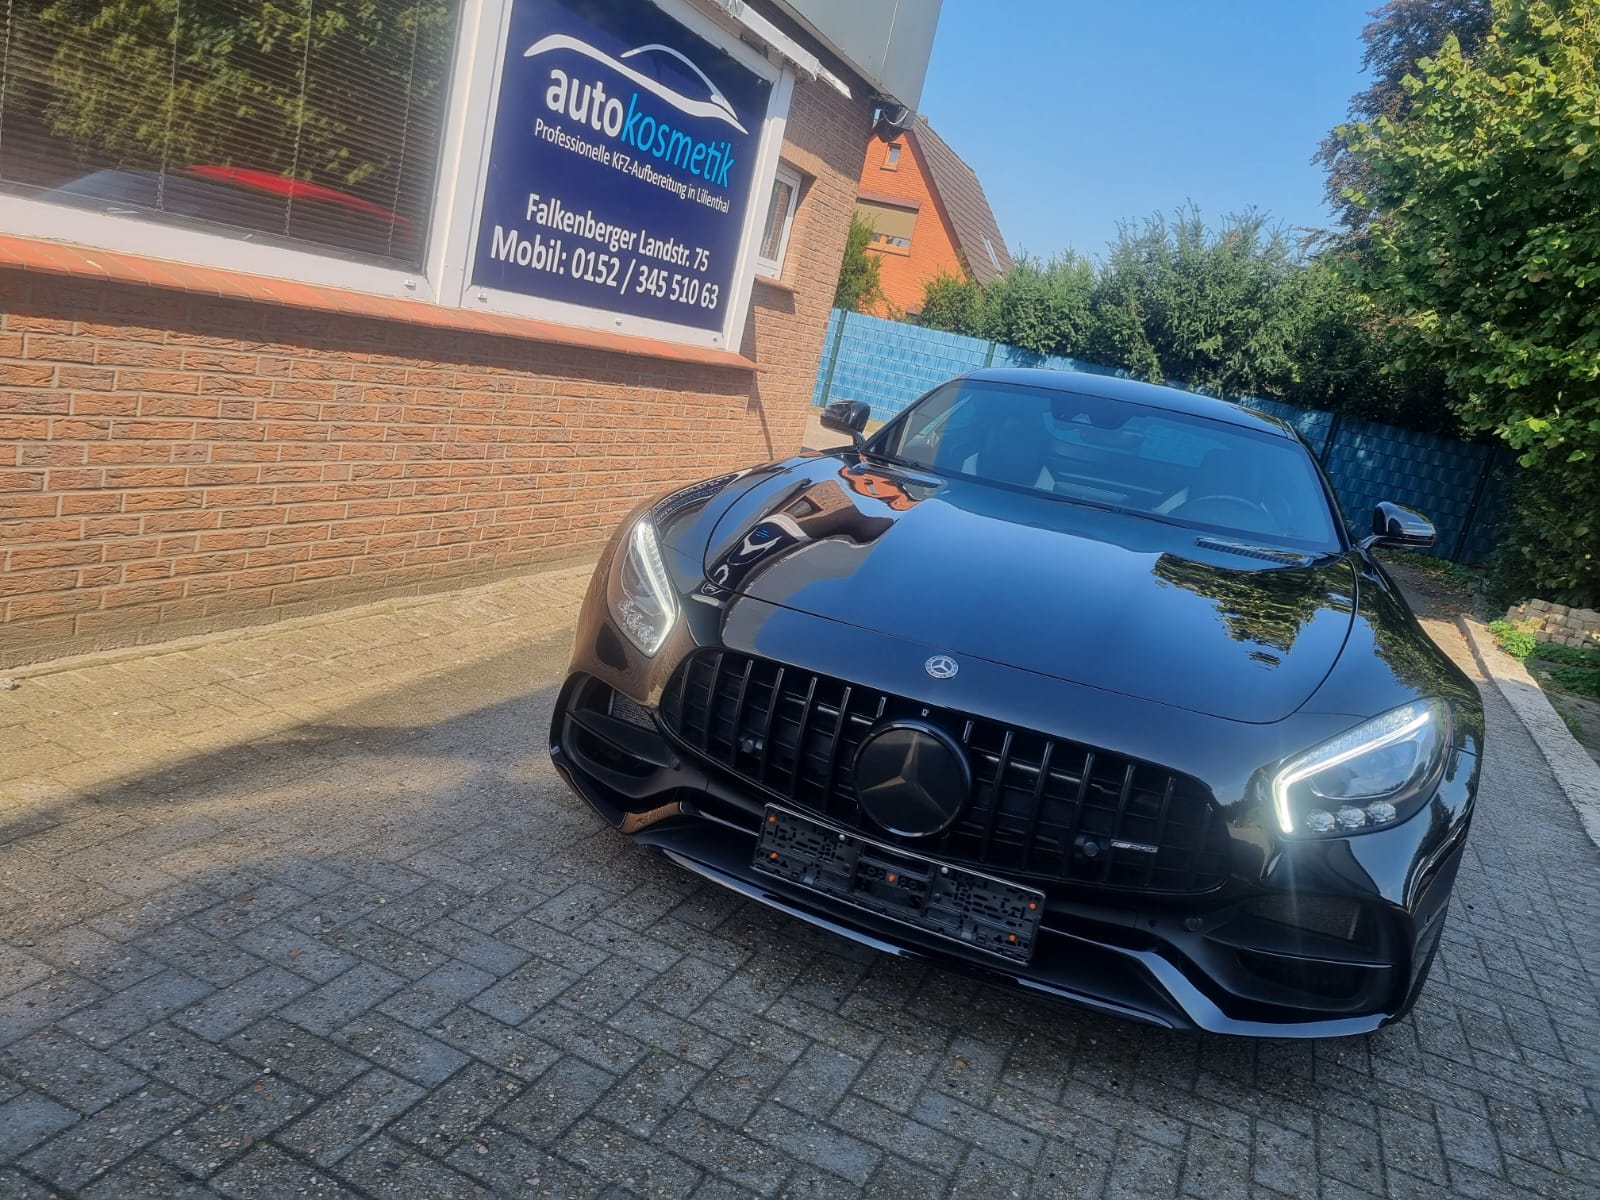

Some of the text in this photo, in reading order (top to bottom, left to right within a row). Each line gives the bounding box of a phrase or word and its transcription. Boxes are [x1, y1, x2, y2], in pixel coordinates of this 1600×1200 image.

[534, 118, 730, 214] Professionelle KFZ-Aufbereitung in Lilienthal
[546, 68, 735, 188] autokosmetik
[490, 224, 567, 275] Mobil:
[571, 247, 620, 288] 0152
[636, 264, 667, 298] 345
[669, 274, 700, 305] 510
[700, 283, 719, 310] 63
[526, 192, 710, 272] Falkenberger Landstr. 75
